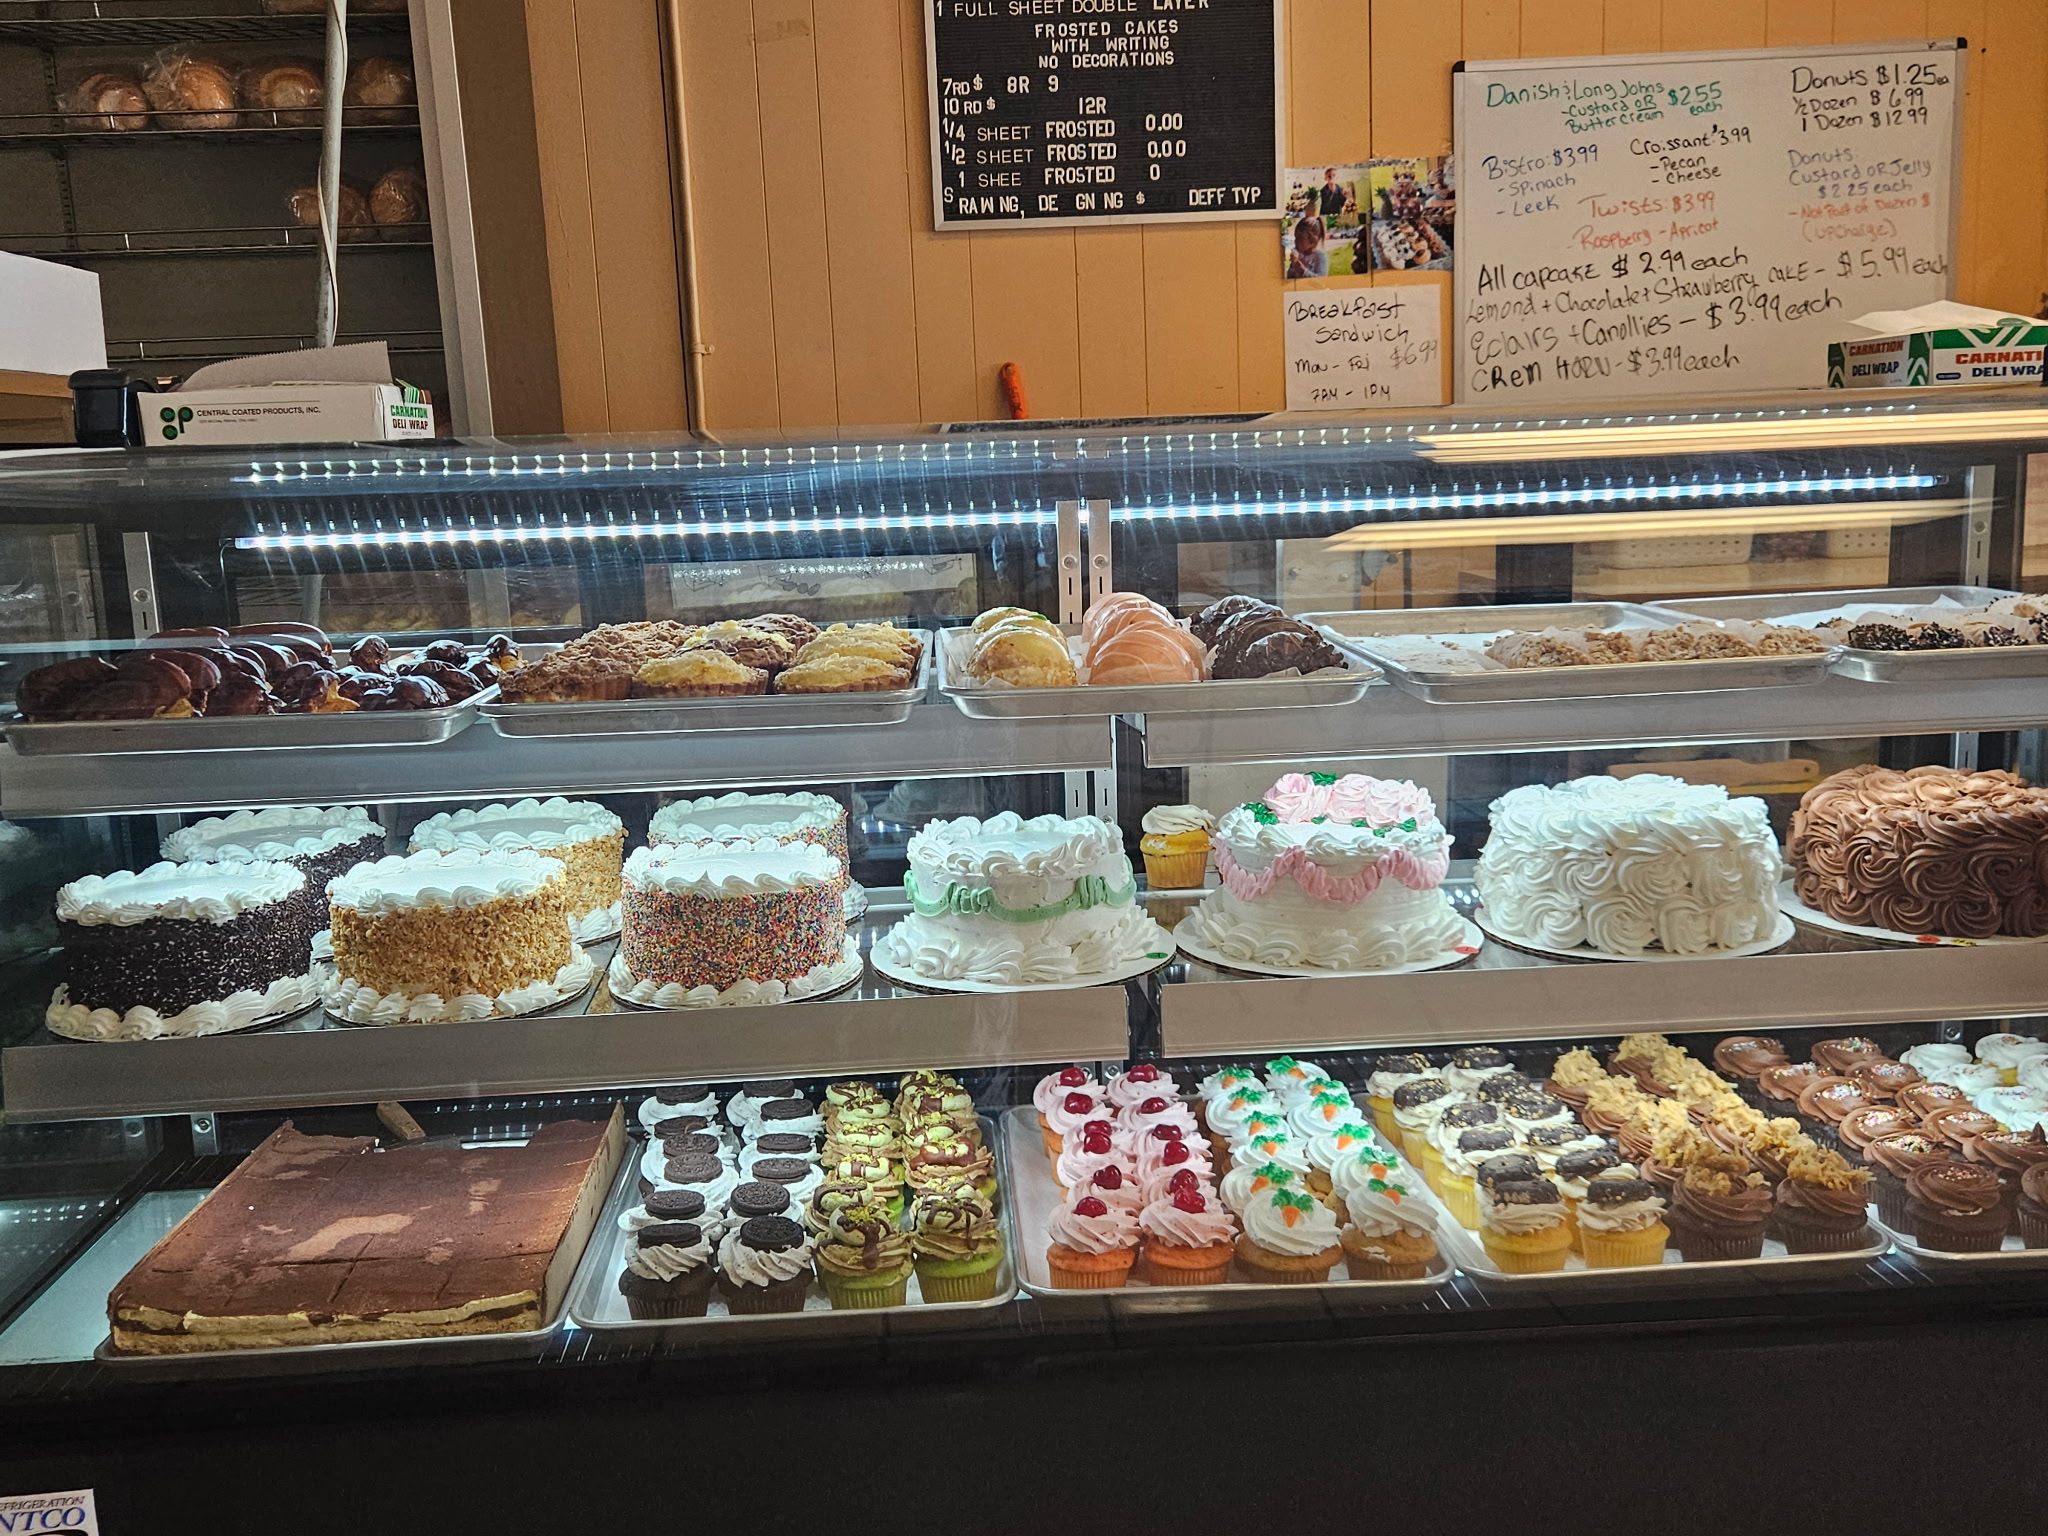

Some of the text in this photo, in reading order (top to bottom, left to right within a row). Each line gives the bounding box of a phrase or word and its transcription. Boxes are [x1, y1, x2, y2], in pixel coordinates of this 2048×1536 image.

[954, 2, 999, 17] FULL
[1008, 0, 1064, 15] SHEET
[1072, 0, 1138, 13] DOUBLE
[1034, 19, 1179, 38] FROSTED CAKES
[1051, 36, 1170, 53] WITH WRITING
[1038, 51, 1175, 69] NO DECORATIONS
[1047, 74, 1060, 92] 9
[1791, 66, 1868, 94] Donuts
[1876, 63, 1937, 86] $1.25
[1487, 82, 1560, 108] Danish
[1573, 79, 1618, 101] Long
[1078, 96, 1107, 115] 12R
[1690, 101, 1723, 116] each
[1809, 95, 1858, 111] Dozen
[942, 112, 1183, 142] 1/4 SHEET FROSTED 0.00
[1813, 113, 1863, 131] Dozen
[944, 140, 966, 165] 1/2
[976, 149, 1034, 165] SHEET
[1047, 143, 1118, 162] FROSTED
[958, 170, 966, 188] 1
[977, 172, 1022, 188] SHEE
[1044, 166, 1116, 185] FROSTED
[1789, 163, 1861, 186] Custard
[1890, 158, 1932, 178] Jelly
[1873, 178, 1913, 194] each
[1188, 187, 1227, 206] DEFF
[1231, 186, 1262, 204] TYP
[1477, 263, 1507, 296] All
[1690, 245, 1749, 271] each
[1912, 252, 1949, 275] each
[1784, 287, 1843, 321] each
[1683, 343, 1740, 372] each
[1849, 340, 1905, 357] CARNATION
[1852, 361, 1899, 377] DELI WRAP
[1972, 366, 2007, 377] DELI
[196, 409, 231, 417] CENTRAL
[232, 408, 262, 416] COATED
[305, 406, 321, 414] INC.
[390, 404, 429, 419] CARNATION
[392, 418, 429, 430] DELI WRAP
